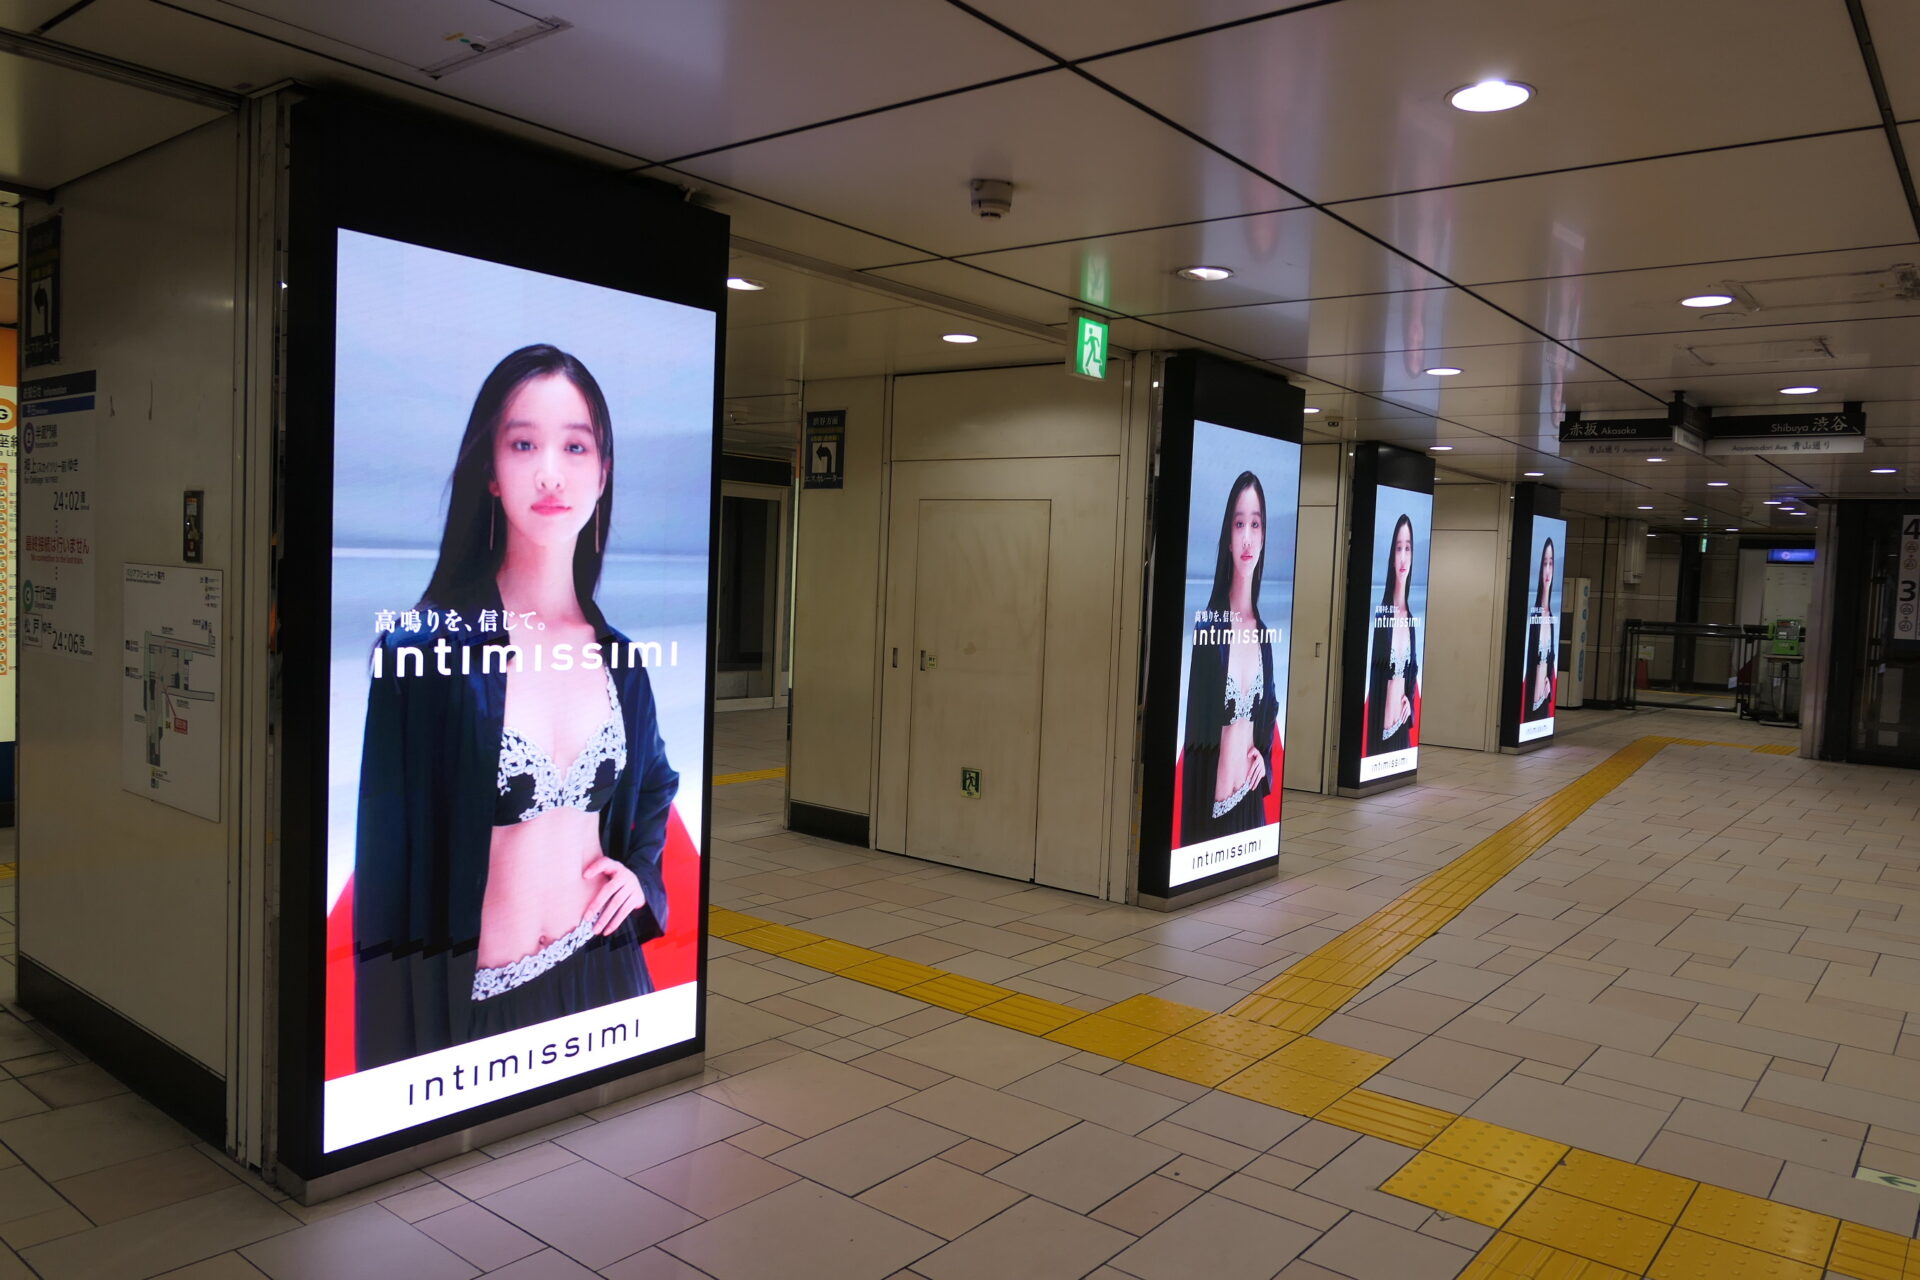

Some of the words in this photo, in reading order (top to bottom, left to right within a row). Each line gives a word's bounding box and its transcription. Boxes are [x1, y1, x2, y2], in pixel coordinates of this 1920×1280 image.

[1570, 422, 1598, 436] 赤坂
[1601, 425, 1637, 435] Akasaka
[1771, 423, 1809, 434] Shibuya
[1812, 415, 1848, 431] 渋谷
[53, 491, 79, 511] 24:02
[1904, 518, 1920, 540] 4
[1899, 581, 1917, 602] 3
[374, 609, 546, 633] 高鳴りを、信じて。
[1374, 615, 1421, 628] intimissimi
[52, 631, 79, 654] 24:06
[1193, 625, 1282, 645] intimissimi
[373, 638, 678, 679] intimissimi
[1192, 839, 1262, 870] intimissimi
[408, 1019, 640, 1106] intimissimi
